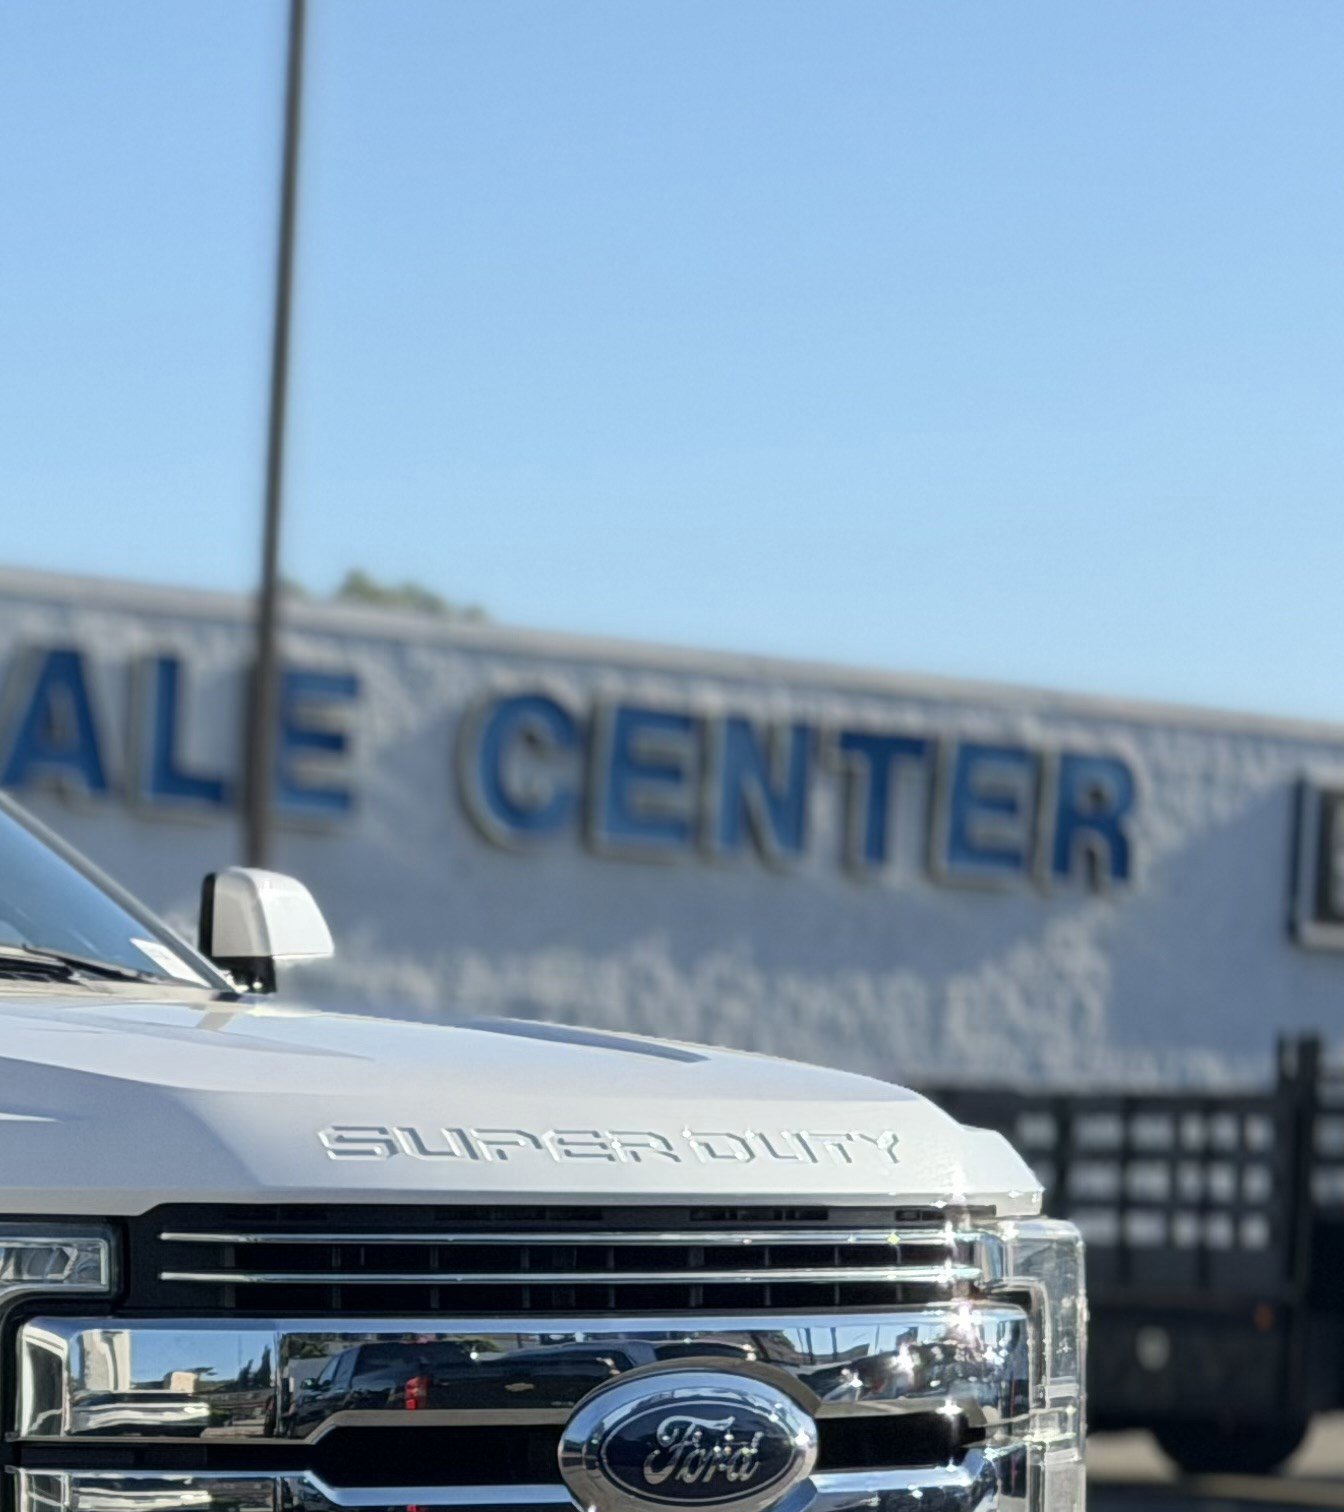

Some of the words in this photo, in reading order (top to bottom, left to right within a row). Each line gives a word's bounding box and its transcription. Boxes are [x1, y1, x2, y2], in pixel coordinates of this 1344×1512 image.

[462, 692, 1138, 885] CENTER
[316, 1124, 683, 1165] SUPER
[681, 1125, 902, 1166] DUTY
[642, 1414, 764, 1486] Ford
